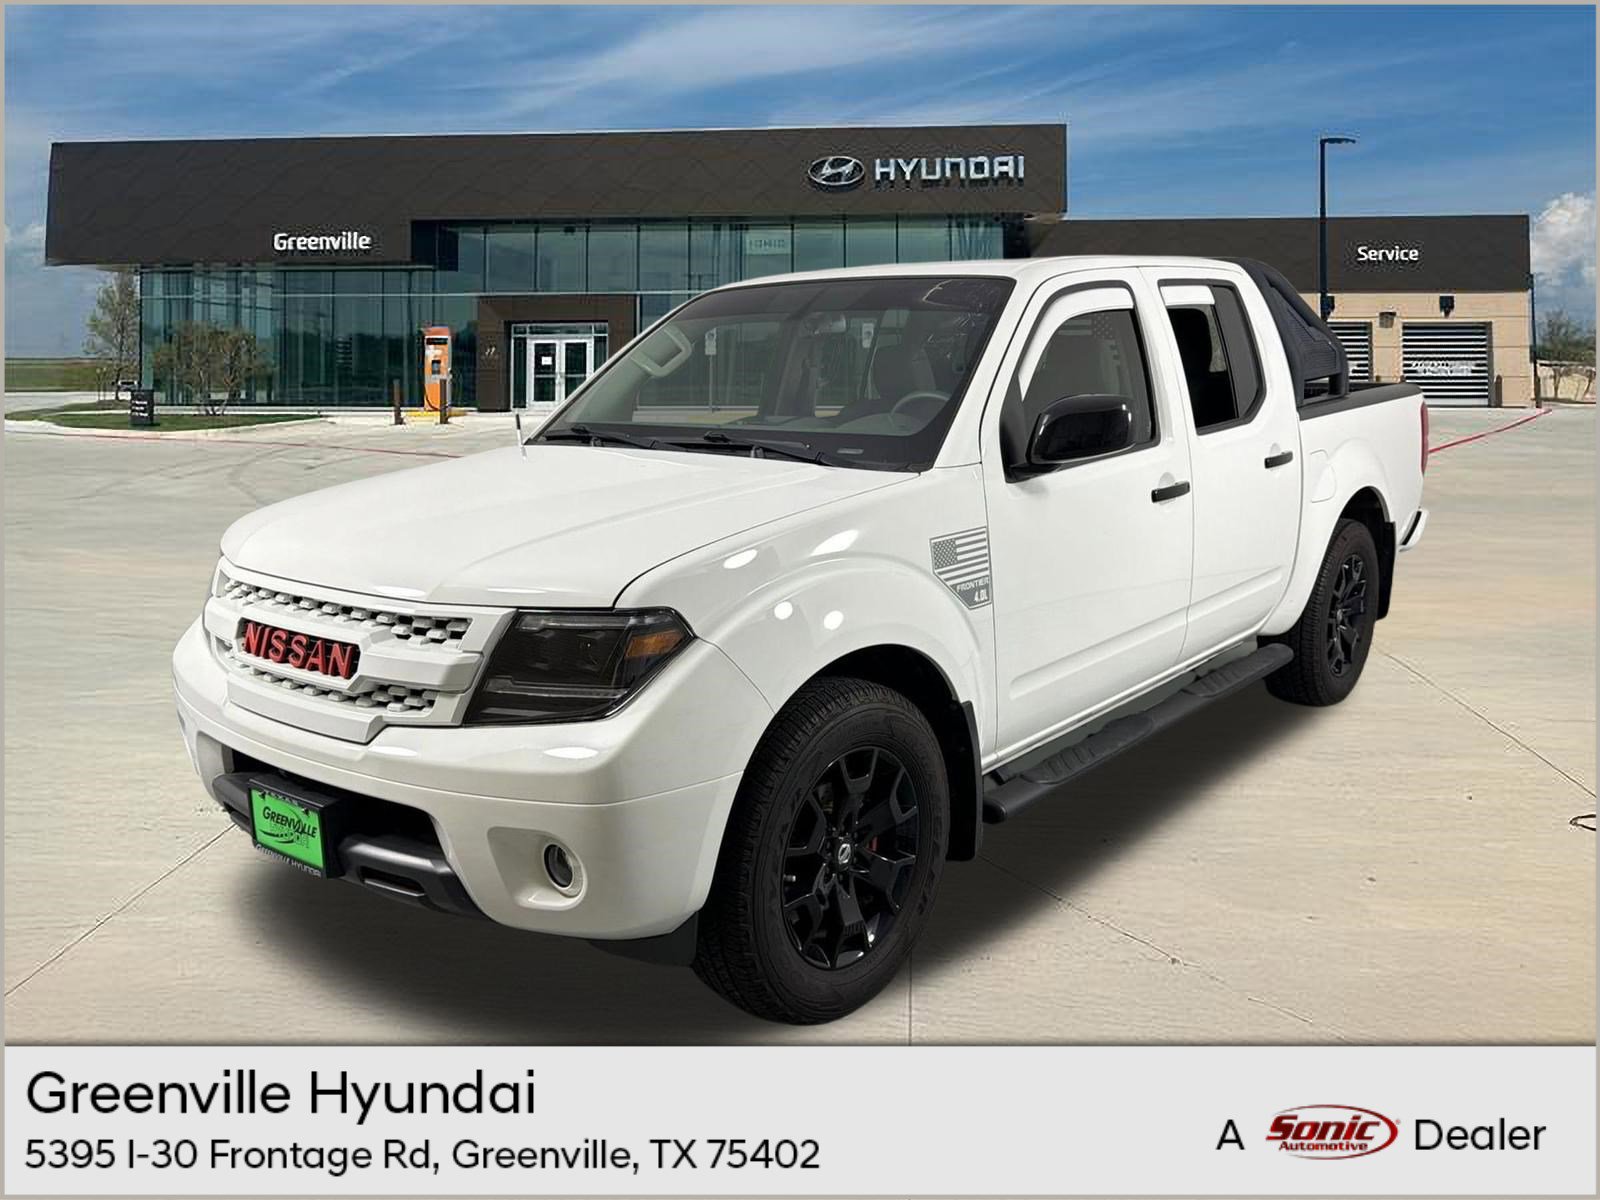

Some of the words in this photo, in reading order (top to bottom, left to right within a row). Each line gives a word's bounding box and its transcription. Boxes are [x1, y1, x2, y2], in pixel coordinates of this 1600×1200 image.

[875, 155, 1025, 181] HYUNDAI
[273, 231, 372, 250] Greenville
[1357, 246, 1419, 261] Service
[243, 621, 353, 680] NISSAN
[262, 806, 318, 839] GREENVILLE
